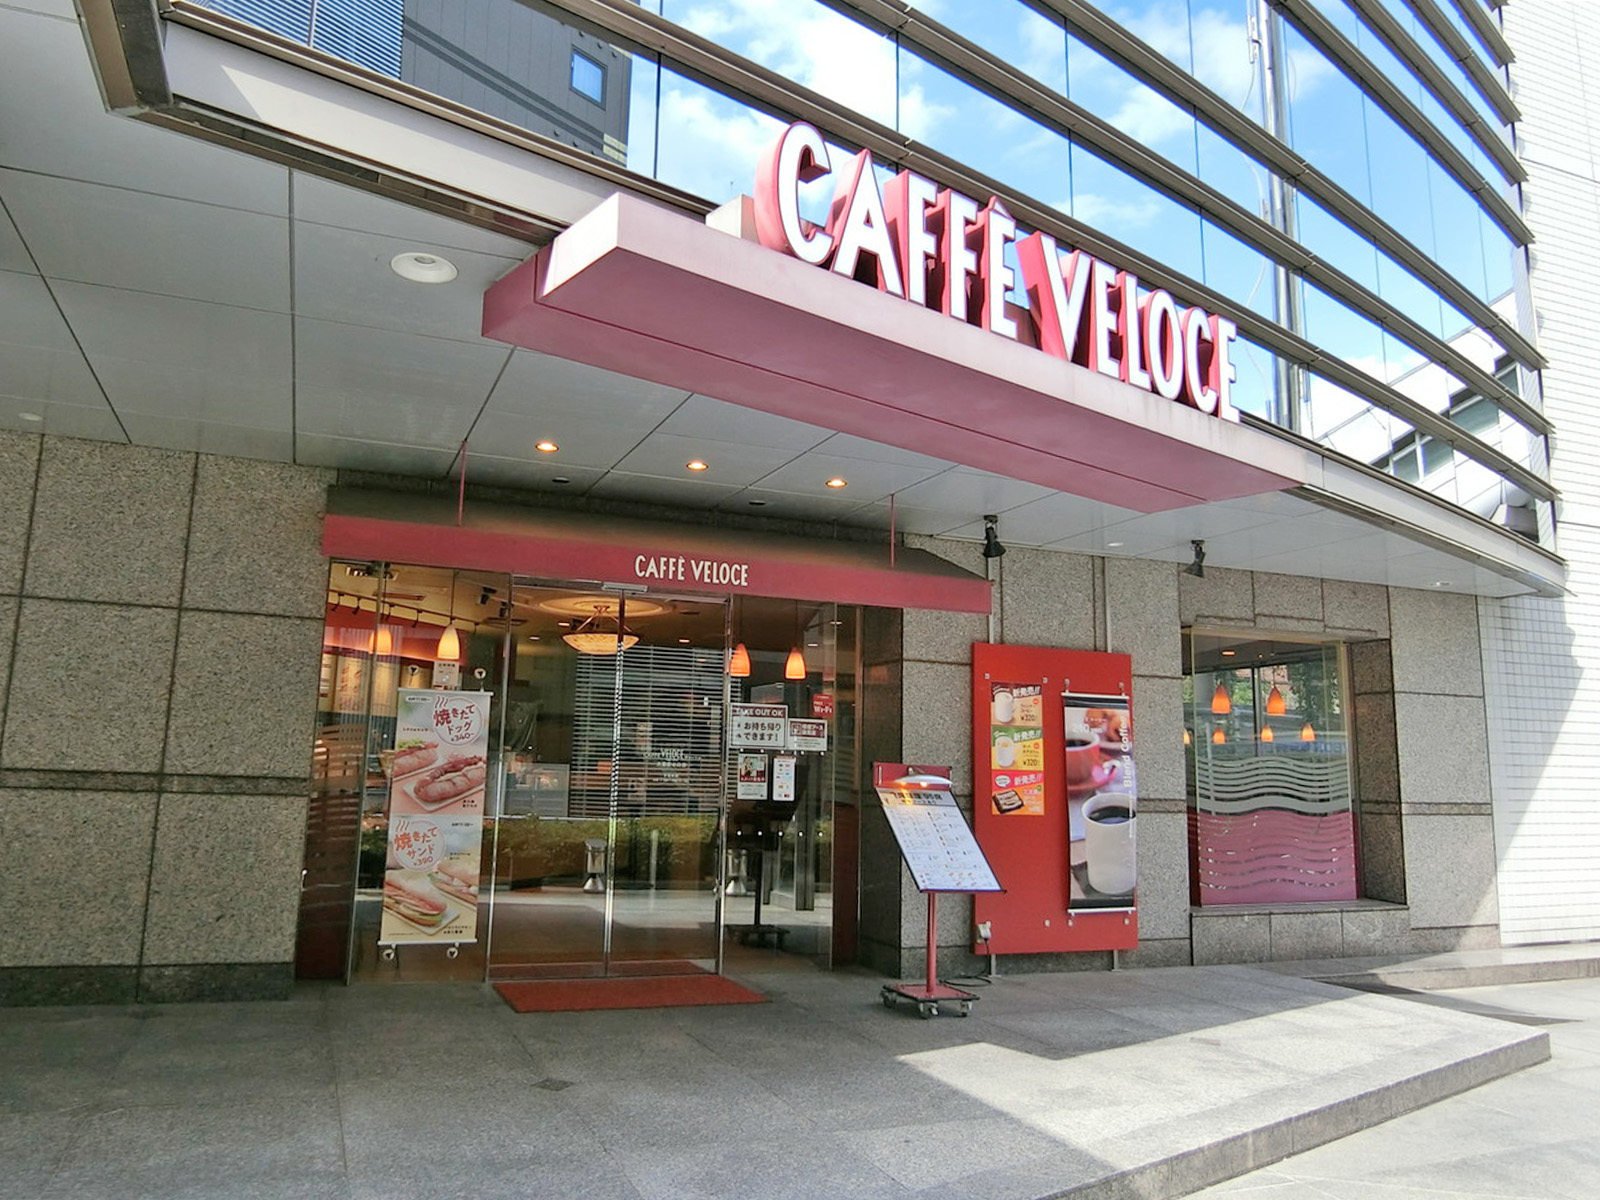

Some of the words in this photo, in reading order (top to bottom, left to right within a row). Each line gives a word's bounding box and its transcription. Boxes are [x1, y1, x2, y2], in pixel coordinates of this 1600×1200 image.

[1035, 231, 1241, 424] VELOCE
[634, 554, 686, 581] CAFFÈ
[690, 559, 749, 587] VELOCE
[433, 703, 476, 727] 焼きたて
[734, 707, 754, 716] TAKE
[754, 708, 771, 717] OUT
[771, 709, 783, 717] OK
[447, 720, 473, 736] ドッグ
[743, 721, 782, 732] お持ち帰り
[1121, 754, 1133, 789] Blend
[393, 826, 438, 852] 焼きたて
